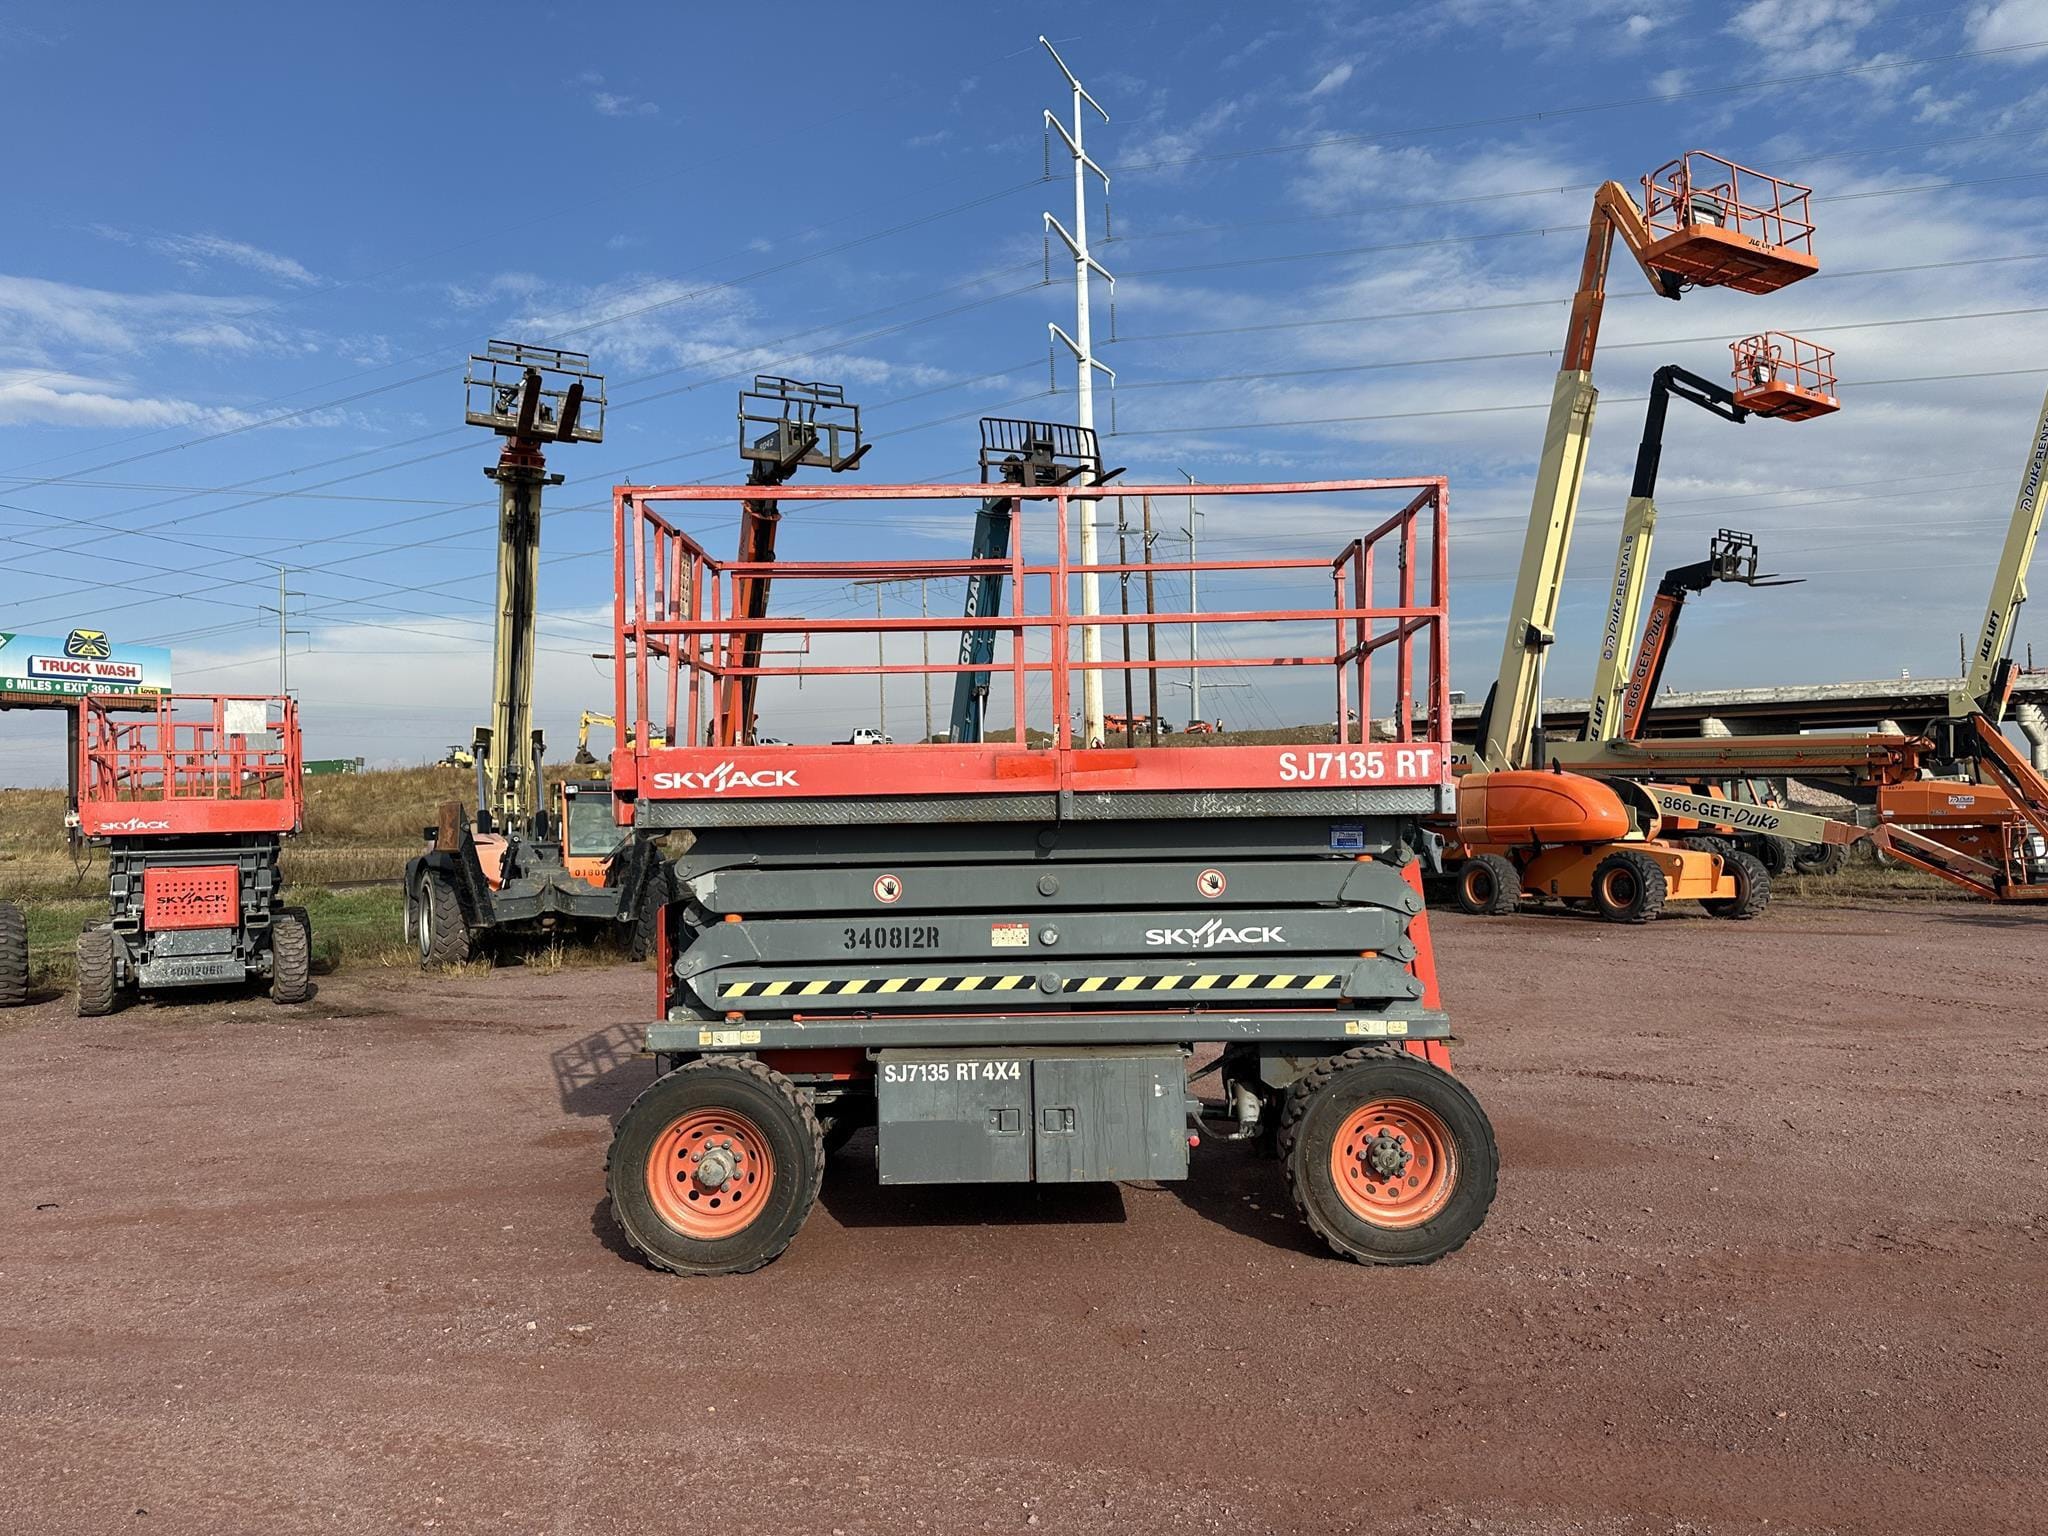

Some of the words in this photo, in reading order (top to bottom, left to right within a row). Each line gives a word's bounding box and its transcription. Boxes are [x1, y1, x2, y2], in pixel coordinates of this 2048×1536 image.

[1616, 535, 1633, 596] RENTALS
[1980, 639, 1992, 661] JLG
[1986, 610, 2000, 638] LIFT
[40, 659, 91, 674] TRUCK
[95, 663, 136, 677] WASH
[6, 679, 13, 689] 6
[17, 679, 51, 691] MILES
[64, 683, 88, 693] EXIT
[91, 685, 111, 694] 399
[123, 686, 136, 695] AT
[1594, 695, 1605, 726] LIFT
[653, 761, 800, 792] SKYJACK
[1279, 751, 1384, 781] SJ7135
[1396, 749, 1434, 778] RT
[100, 818, 170, 831] SKYJACK
[1658, 796, 1779, 829] -866-GET-Duke
[157, 892, 225, 905] SKYJACK
[844, 926, 939, 949] 340812R
[1145, 918, 1286, 948] SKYJACK
[884, 1063, 950, 1082] SJ7135
[956, 1062, 979, 1080] RT
[982, 1061, 1021, 1080] 4X4
